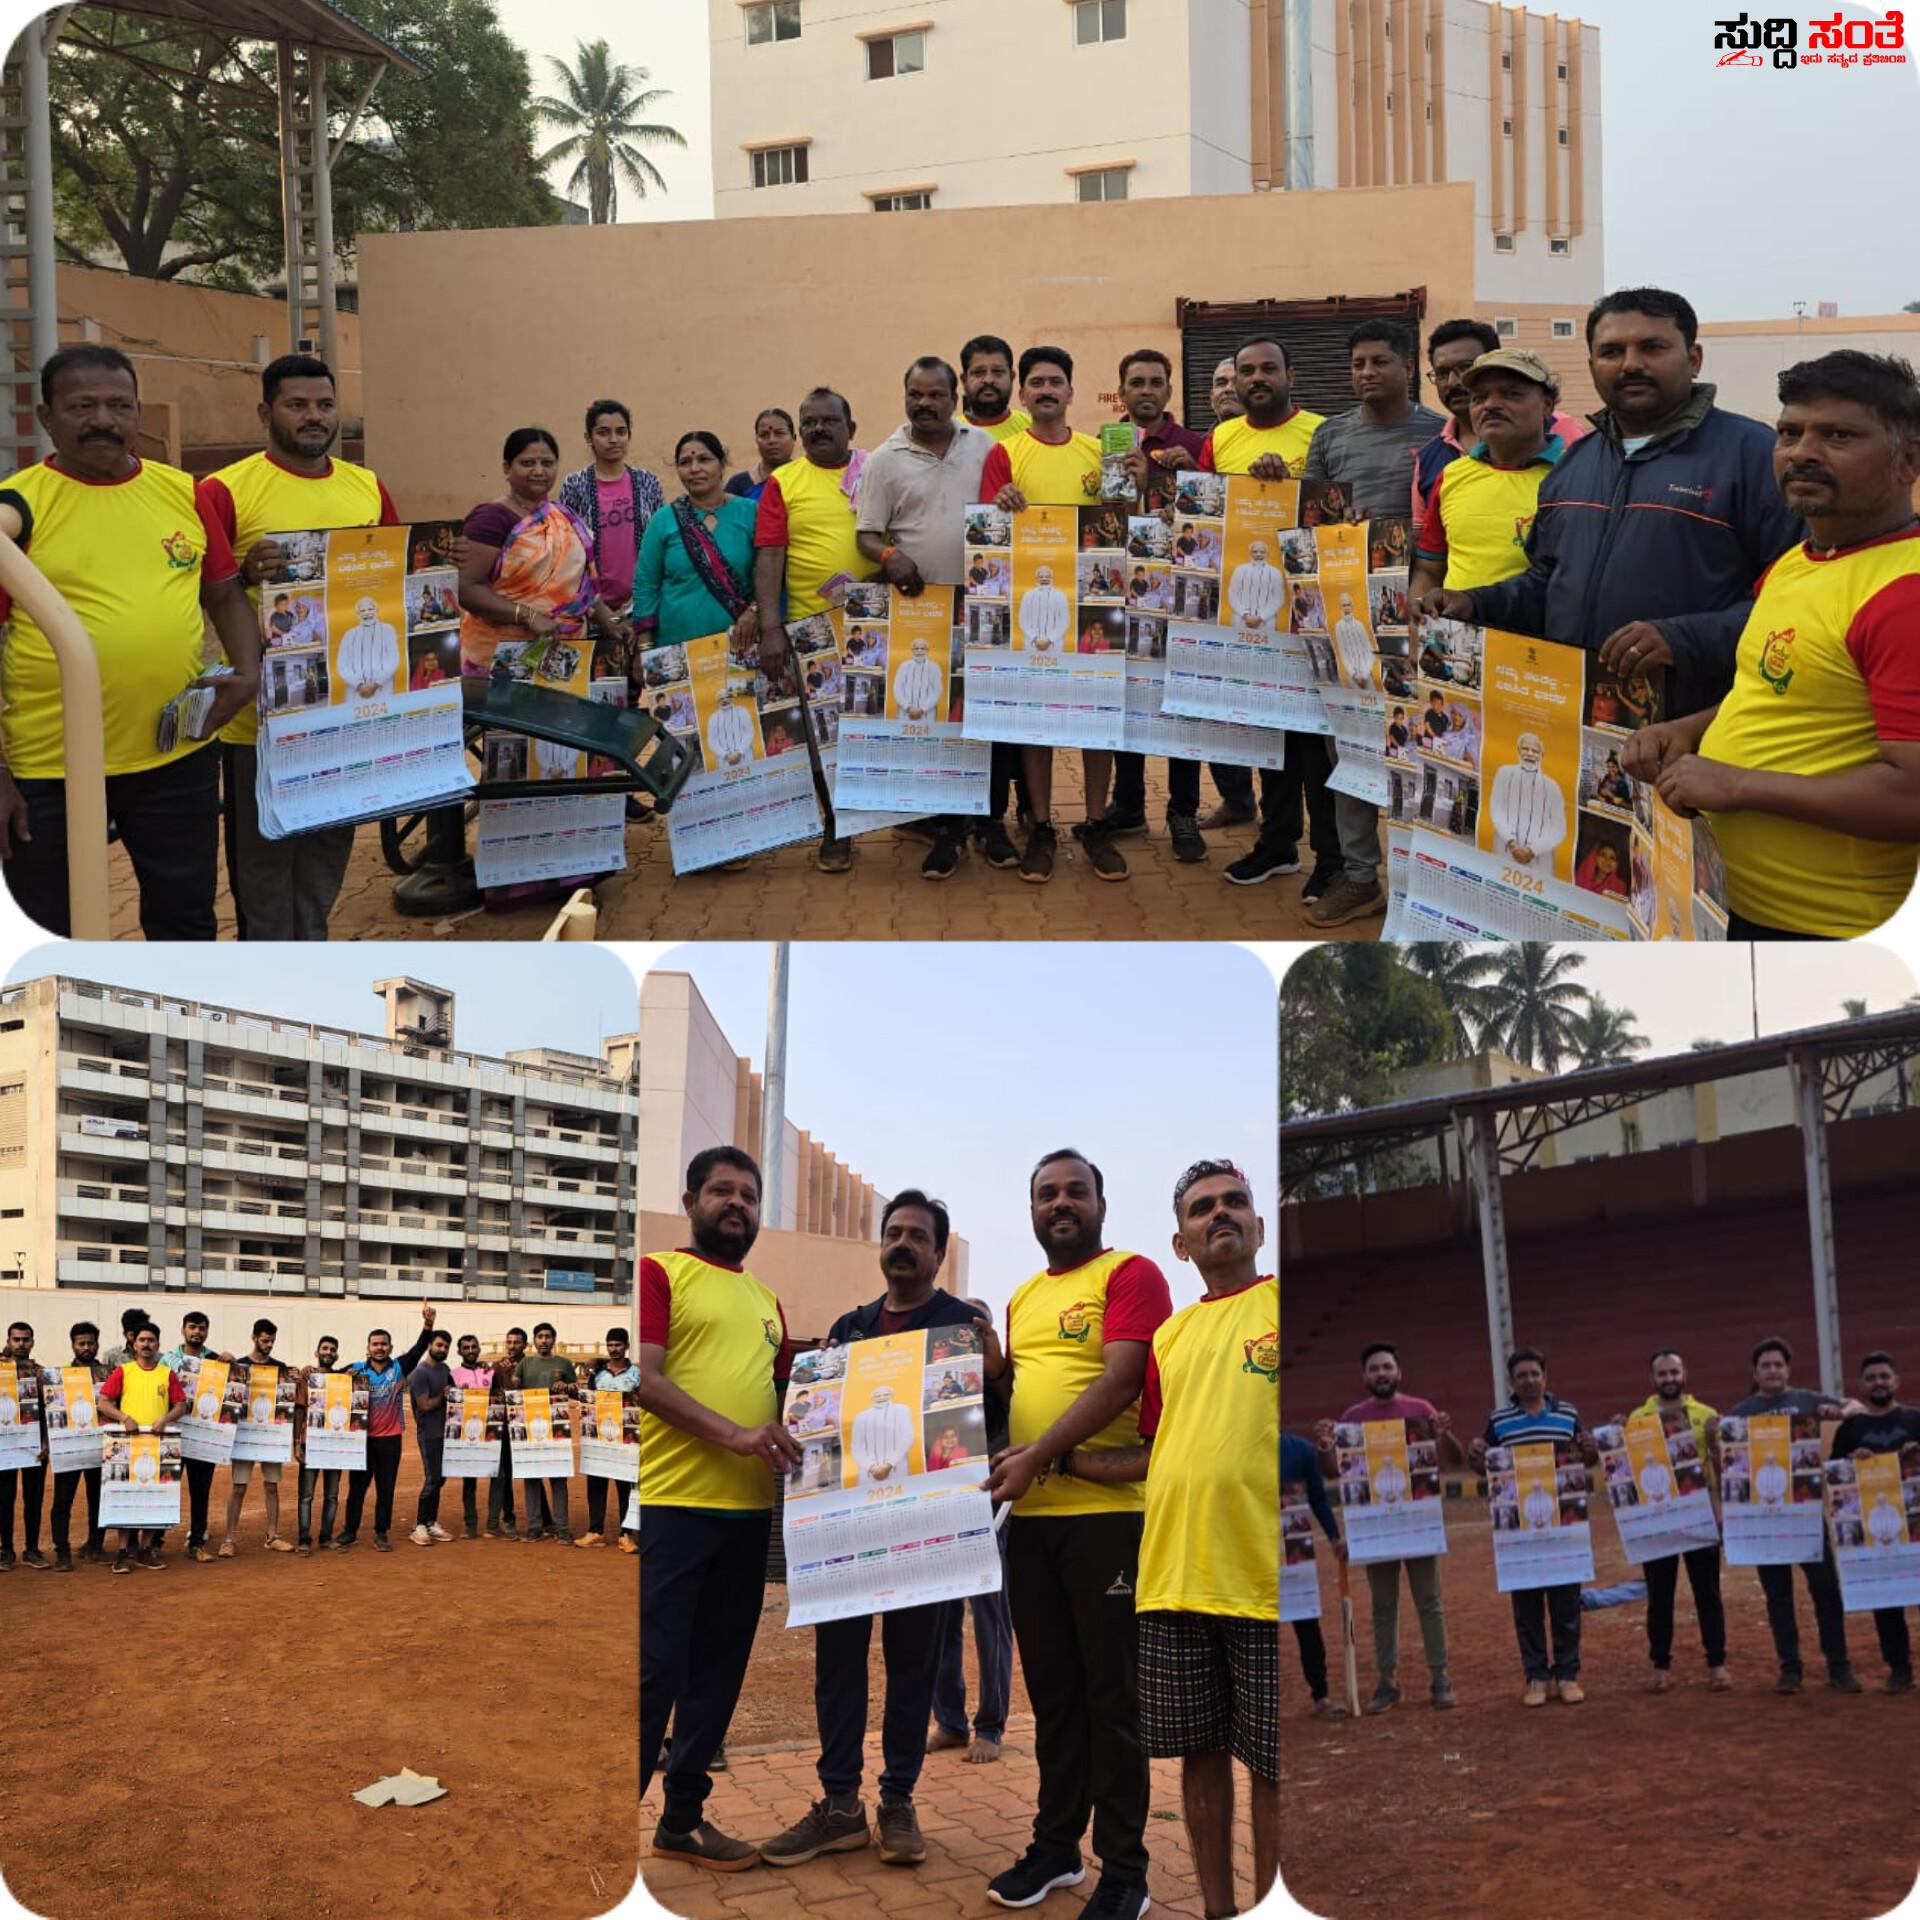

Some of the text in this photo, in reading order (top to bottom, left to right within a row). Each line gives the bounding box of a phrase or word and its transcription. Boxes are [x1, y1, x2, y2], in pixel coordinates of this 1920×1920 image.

[1098, 392, 1119, 403] FIRE
[352, 702, 389, 720] 2024
[1501, 865, 1545, 896] 2024
[865, 1484, 904, 1504] 2024
